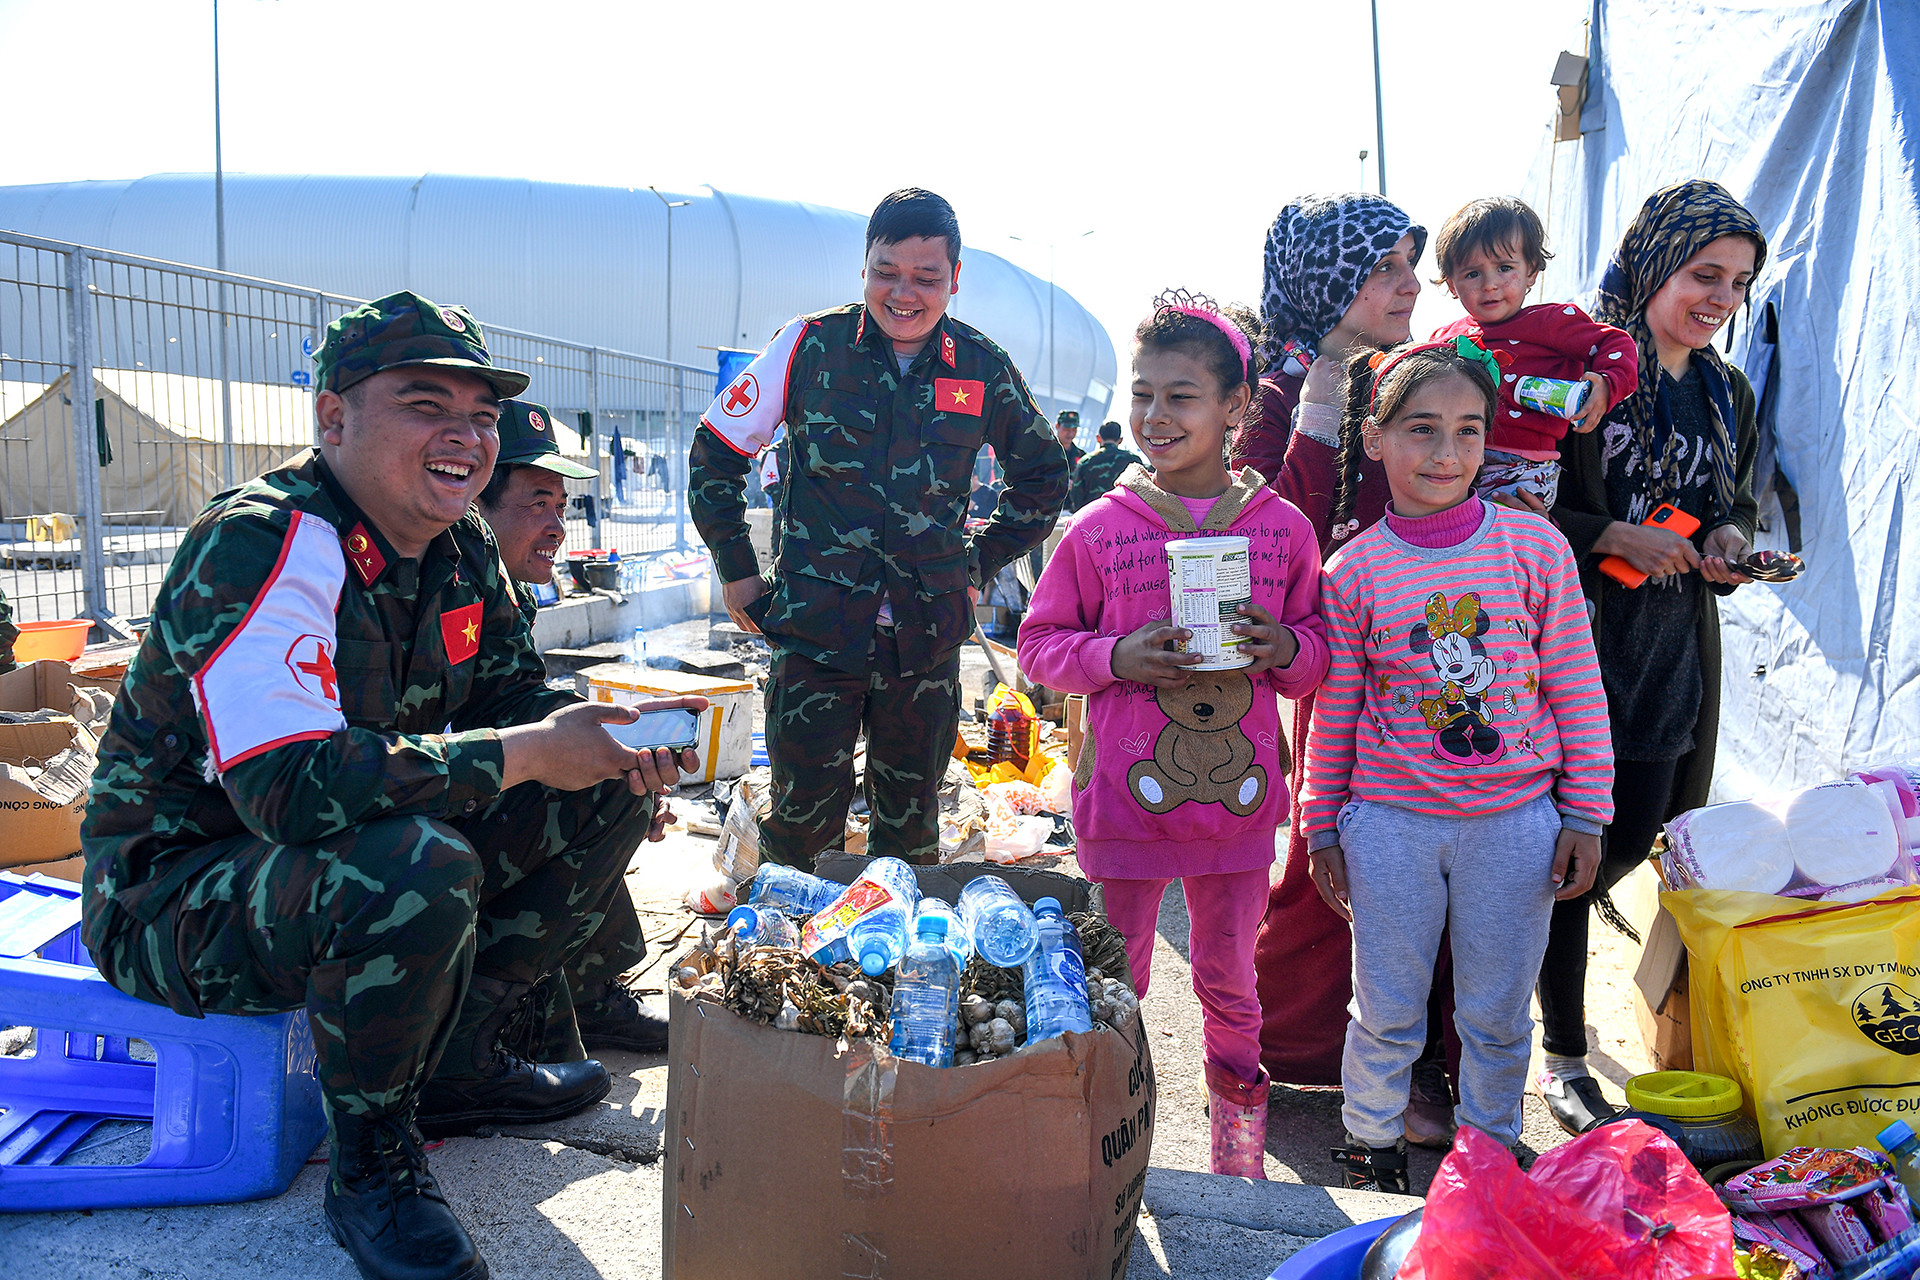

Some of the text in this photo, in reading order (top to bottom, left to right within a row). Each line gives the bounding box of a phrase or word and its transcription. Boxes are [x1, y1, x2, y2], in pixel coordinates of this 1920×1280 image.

[1115, 528, 1139, 555] glad
[1141, 526, 1168, 541] when
[1260, 522, 1270, 537] to
[1273, 528, 1291, 547] you
[1113, 554, 1135, 582] glad
[1138, 550, 1156, 572] for
[1261, 551, 1273, 562] me
[1122, 577, 1130, 595] it
[1133, 579, 1166, 594] cause
[1262, 576, 1275, 598] my
[1773, 973, 1790, 986] TY
[1792, 968, 1830, 983] TNHH
[1832, 965, 1852, 978] SX
[1854, 964, 1875, 977] DV
[1876, 961, 1899, 973] TM
[1874, 1024, 1920, 1043] GEC
[1784, 1102, 1845, 1130] KHÔNG
[1846, 1097, 1893, 1117] ĐƯỢC
[1101, 1115, 1137, 1169] QUÂN
